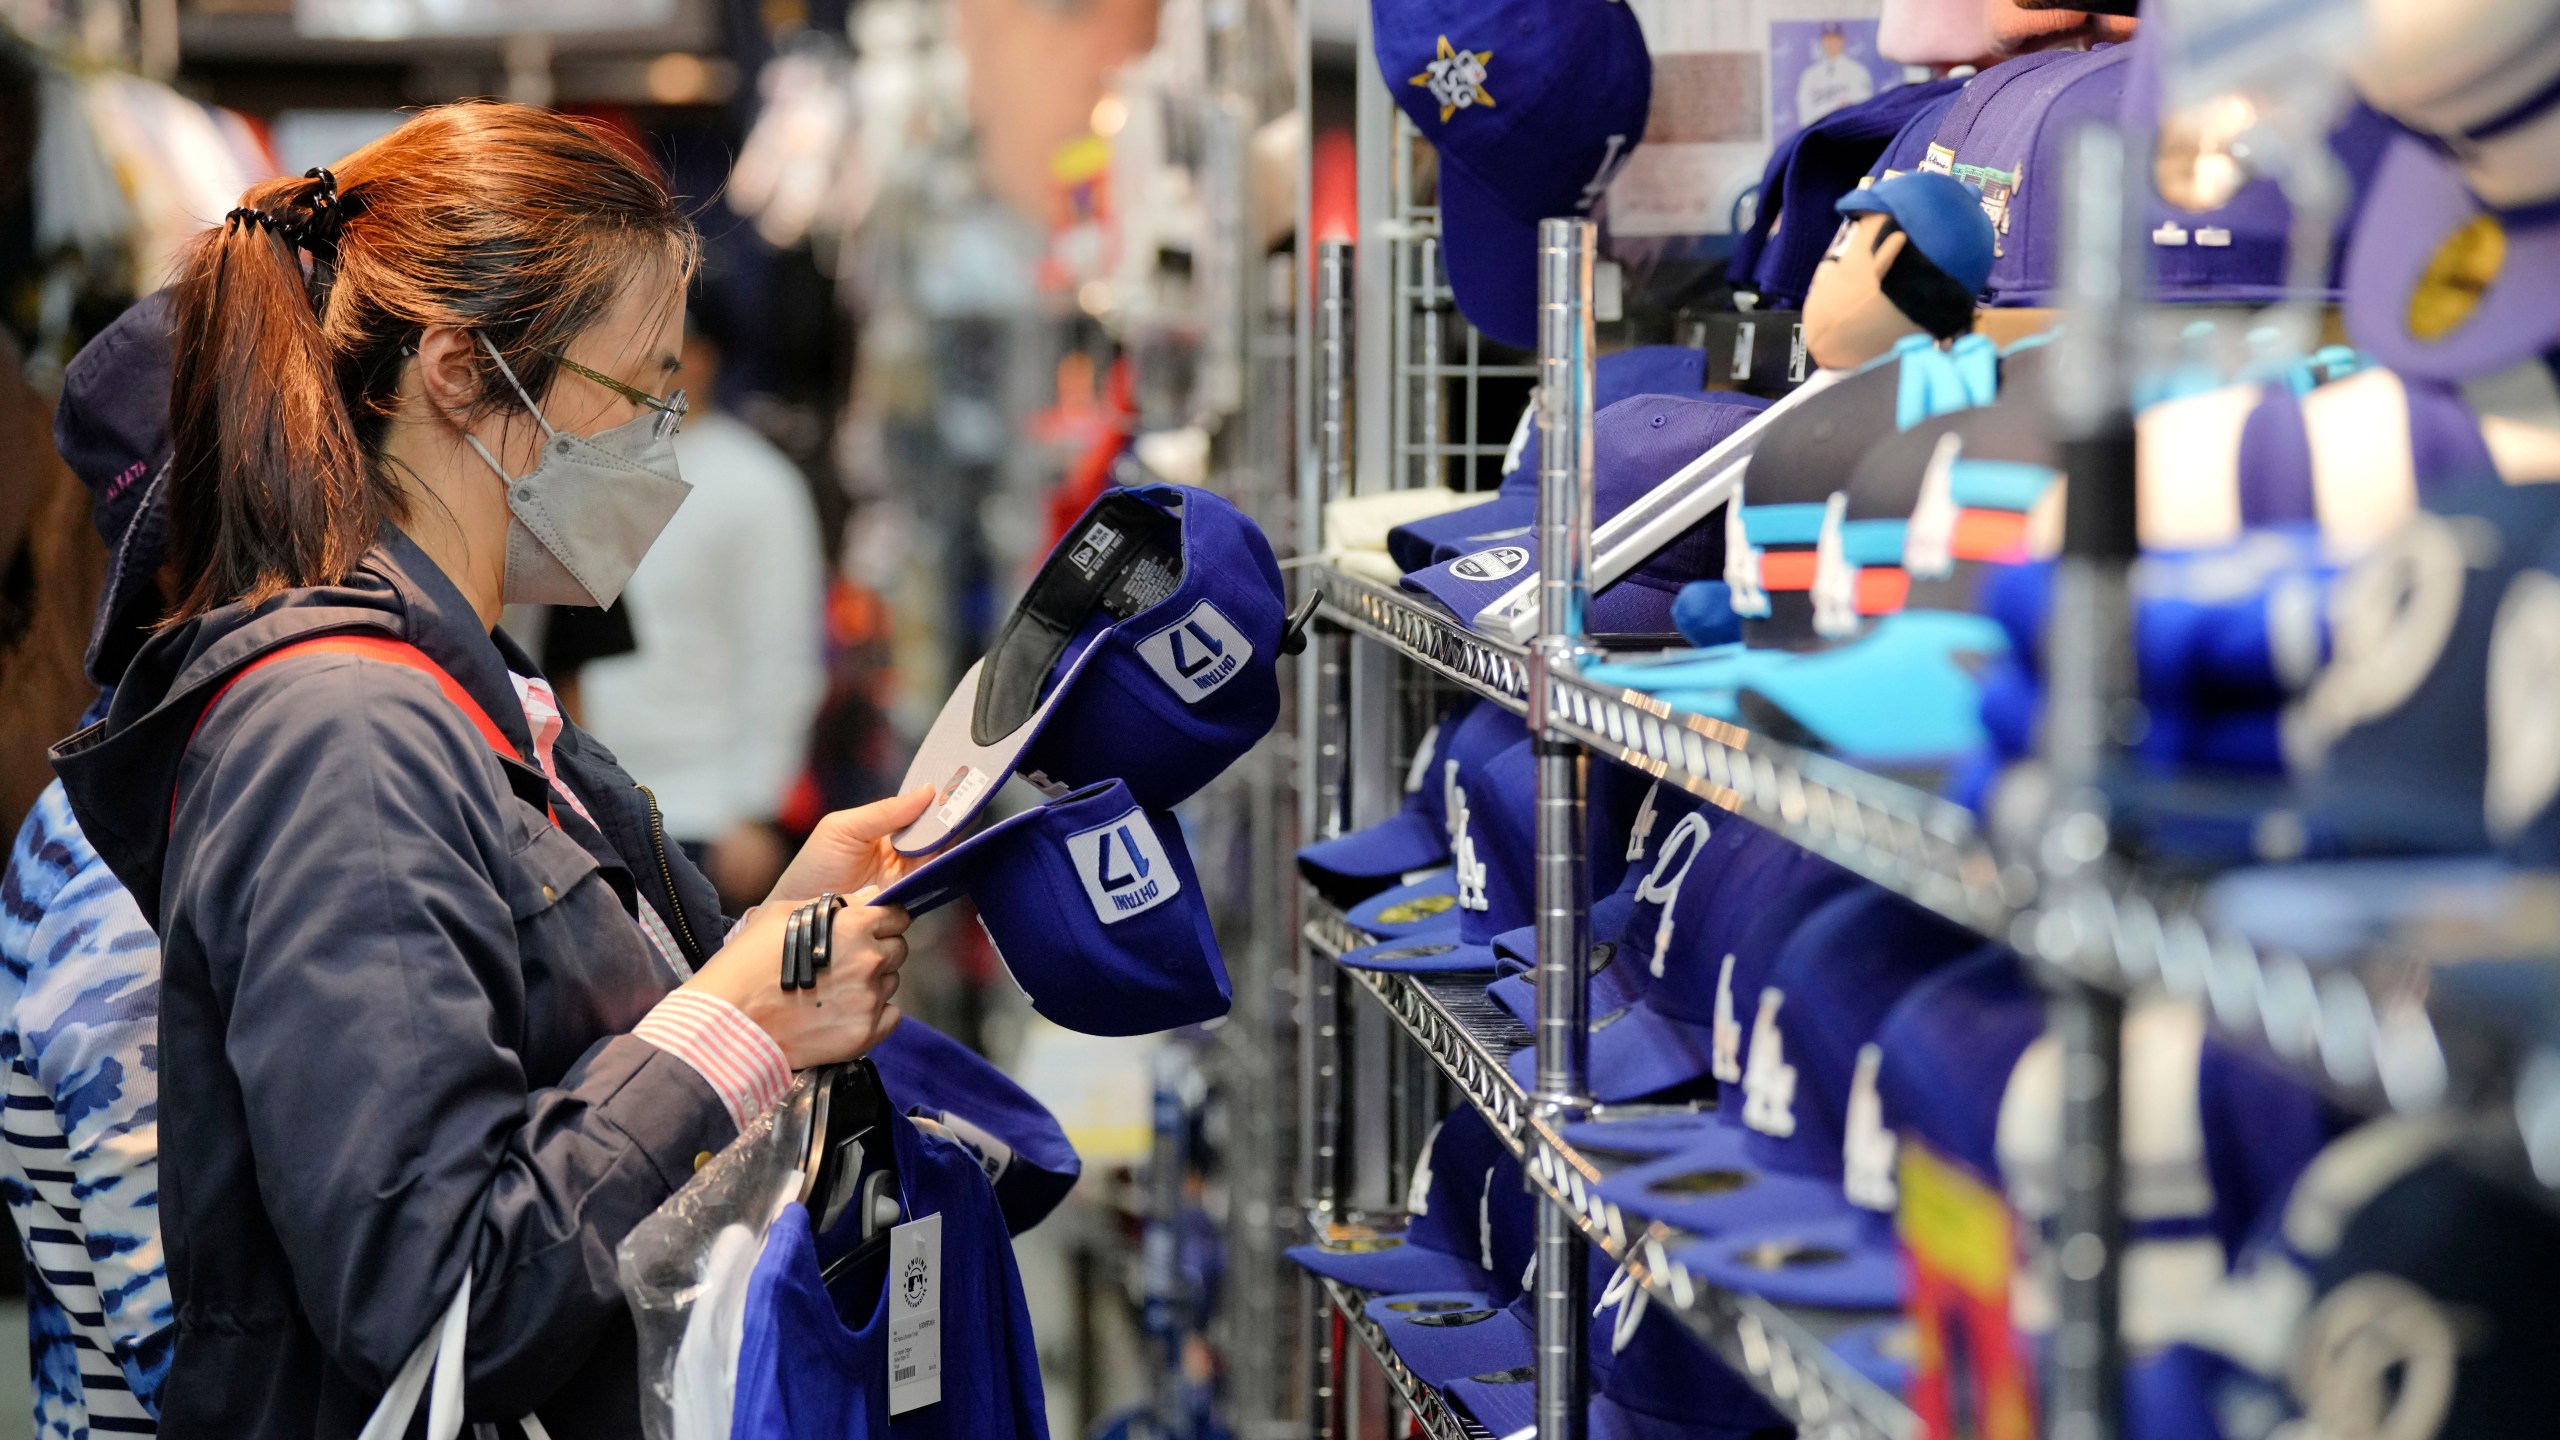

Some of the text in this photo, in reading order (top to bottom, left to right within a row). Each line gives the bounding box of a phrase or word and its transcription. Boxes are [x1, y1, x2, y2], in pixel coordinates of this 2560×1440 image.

[1089, 527, 1104, 541] NEW
[1096, 532, 1110, 547] ERA
[1092, 558, 1105, 571] SIZE
[1101, 546, 1114, 560] FITS
[1110, 532, 1125, 549] MOST
[1169, 619, 1223, 679] 17
[1192, 653, 1237, 690] OHTANI
[1098, 824, 1150, 893] 17
[1111, 878, 1159, 911] OHTANI
[904, 1256, 928, 1278] GENUINE
[904, 1288, 928, 1308] MERCHANDISE
